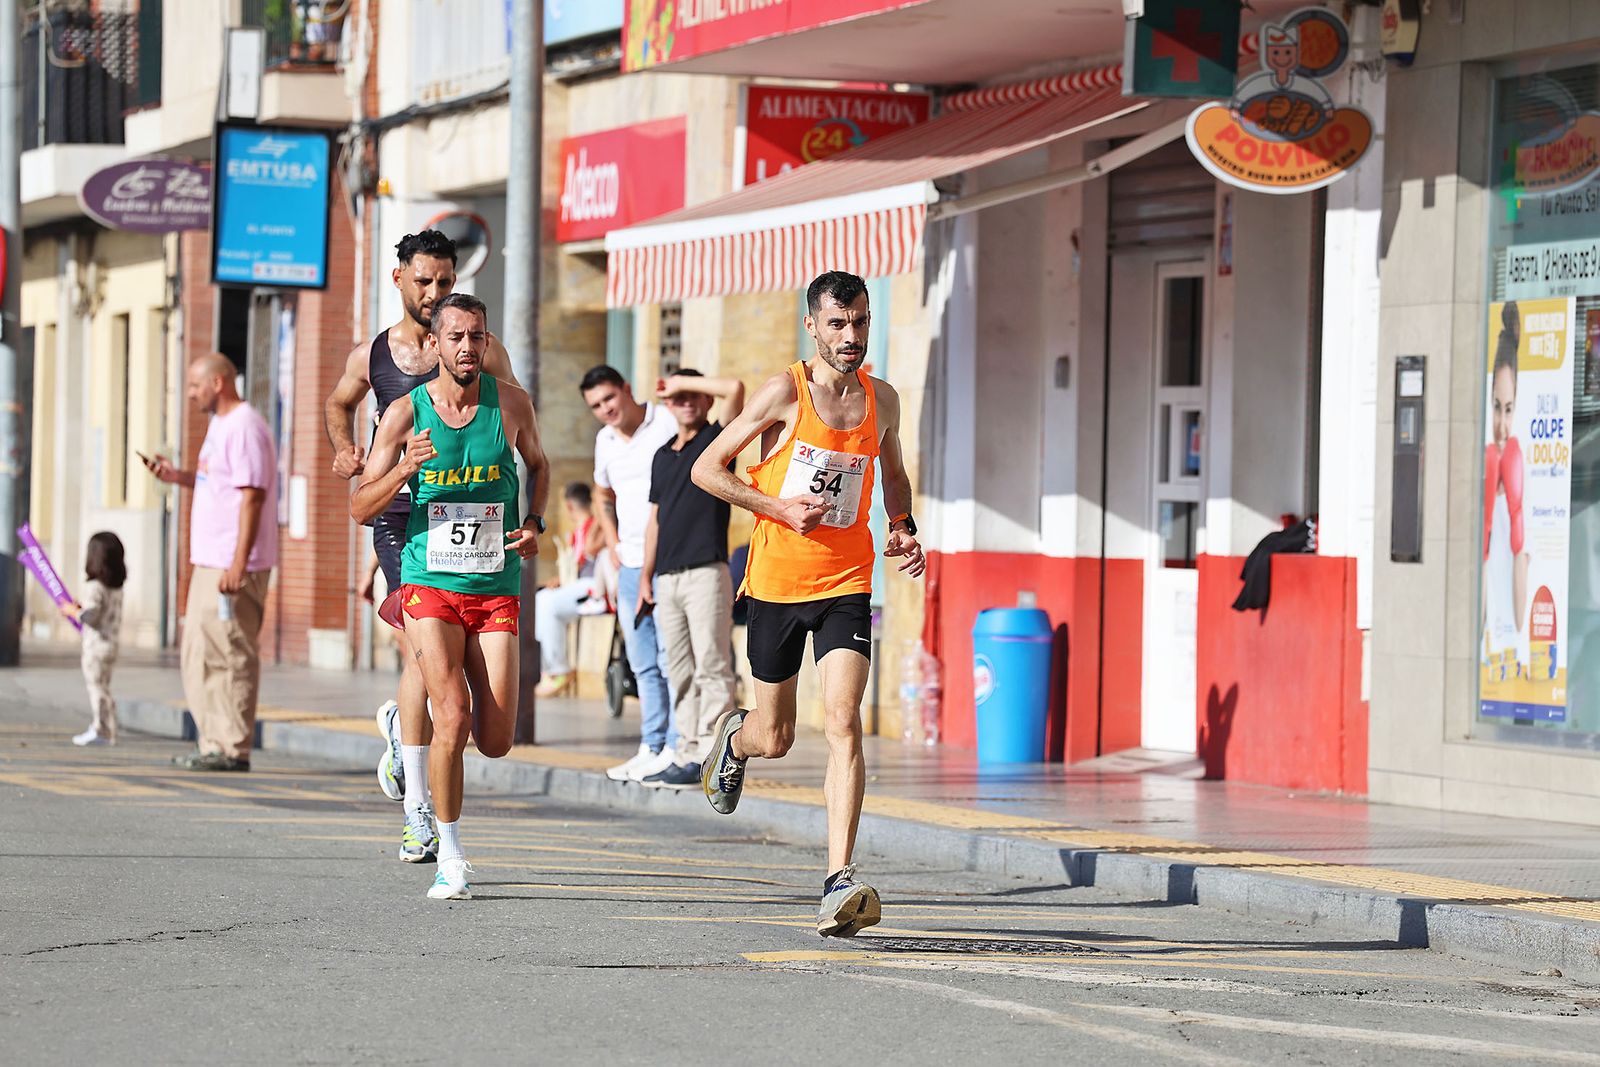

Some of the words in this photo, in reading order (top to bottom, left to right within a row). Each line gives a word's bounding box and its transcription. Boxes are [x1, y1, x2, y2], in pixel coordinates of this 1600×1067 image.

[811, 127, 843, 149] 24
[1215, 123, 1350, 169] POLVILLO
[226, 159, 318, 181] EMTUSA
[1276, 174, 1297, 182] PAN
[561, 146, 620, 223] Adecco
[1554, 193, 1583, 215] Punto
[1508, 251, 1539, 283] ABIERTA
[1551, 247, 1577, 280] HORAS
[1579, 250, 1589, 278] DE
[1531, 418, 1564, 438] GOLPE
[799, 445, 816, 461] 2K
[849, 456, 864, 470] 2K
[1534, 442, 1568, 467] DOLOR
[809, 469, 843, 498] 54
[433, 505, 448, 517] 2K
[485, 505, 499, 517] 2K
[450, 522, 482, 546] 57
[430, 550, 463, 558] CUESTAS
[430, 557, 463, 566] Huelva
